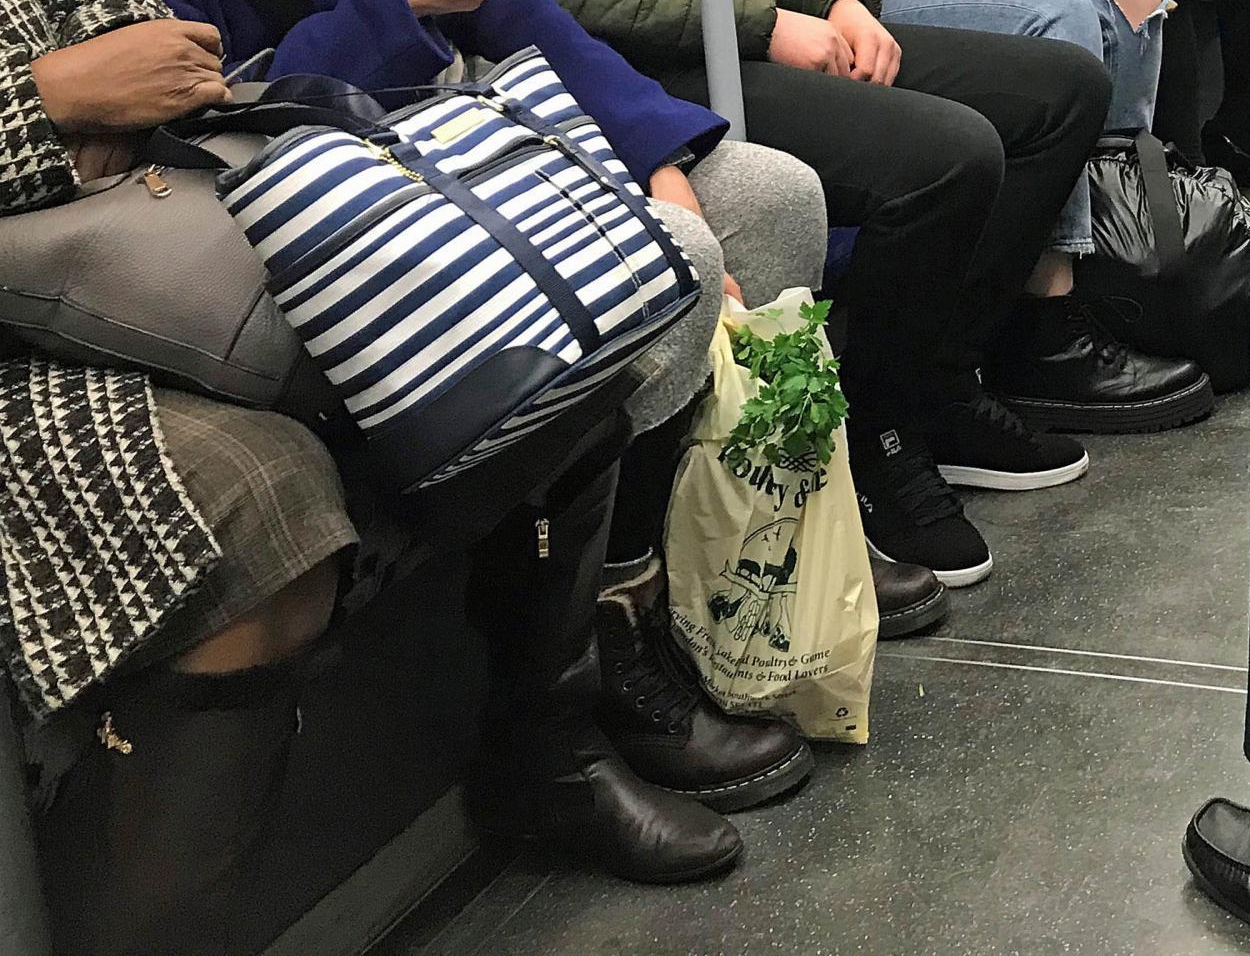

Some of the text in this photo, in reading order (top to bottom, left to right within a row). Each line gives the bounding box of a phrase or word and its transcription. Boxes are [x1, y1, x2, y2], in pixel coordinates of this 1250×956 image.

[800, 648, 831, 665] Game
[755, 670, 766, 682] &
[767, 670, 791, 682] Food
[795, 664, 829, 680] Lovers
